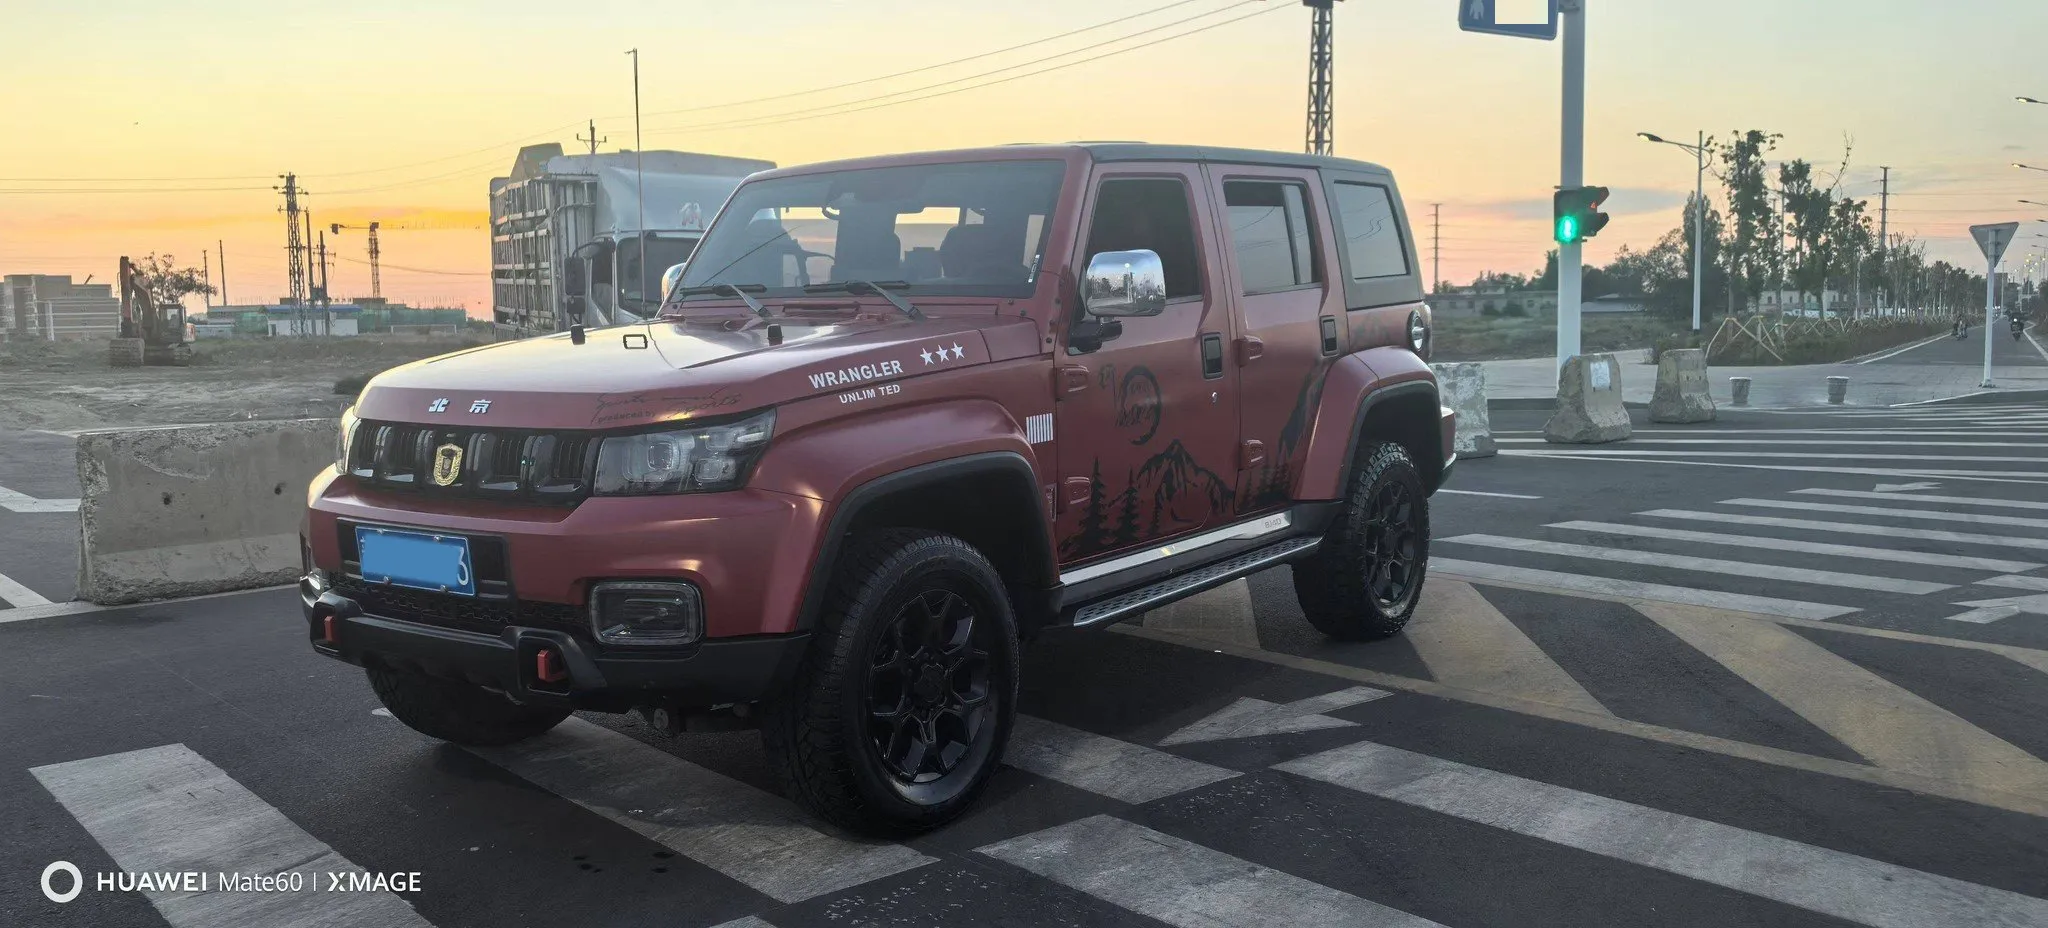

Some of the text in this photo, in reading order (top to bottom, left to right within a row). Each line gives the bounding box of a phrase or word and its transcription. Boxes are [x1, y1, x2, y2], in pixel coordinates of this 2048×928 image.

[808, 360, 903, 388] WRANGLER
[839, 384, 900, 404] UNLIM TED
[428, 398, 492, 413] 北京
